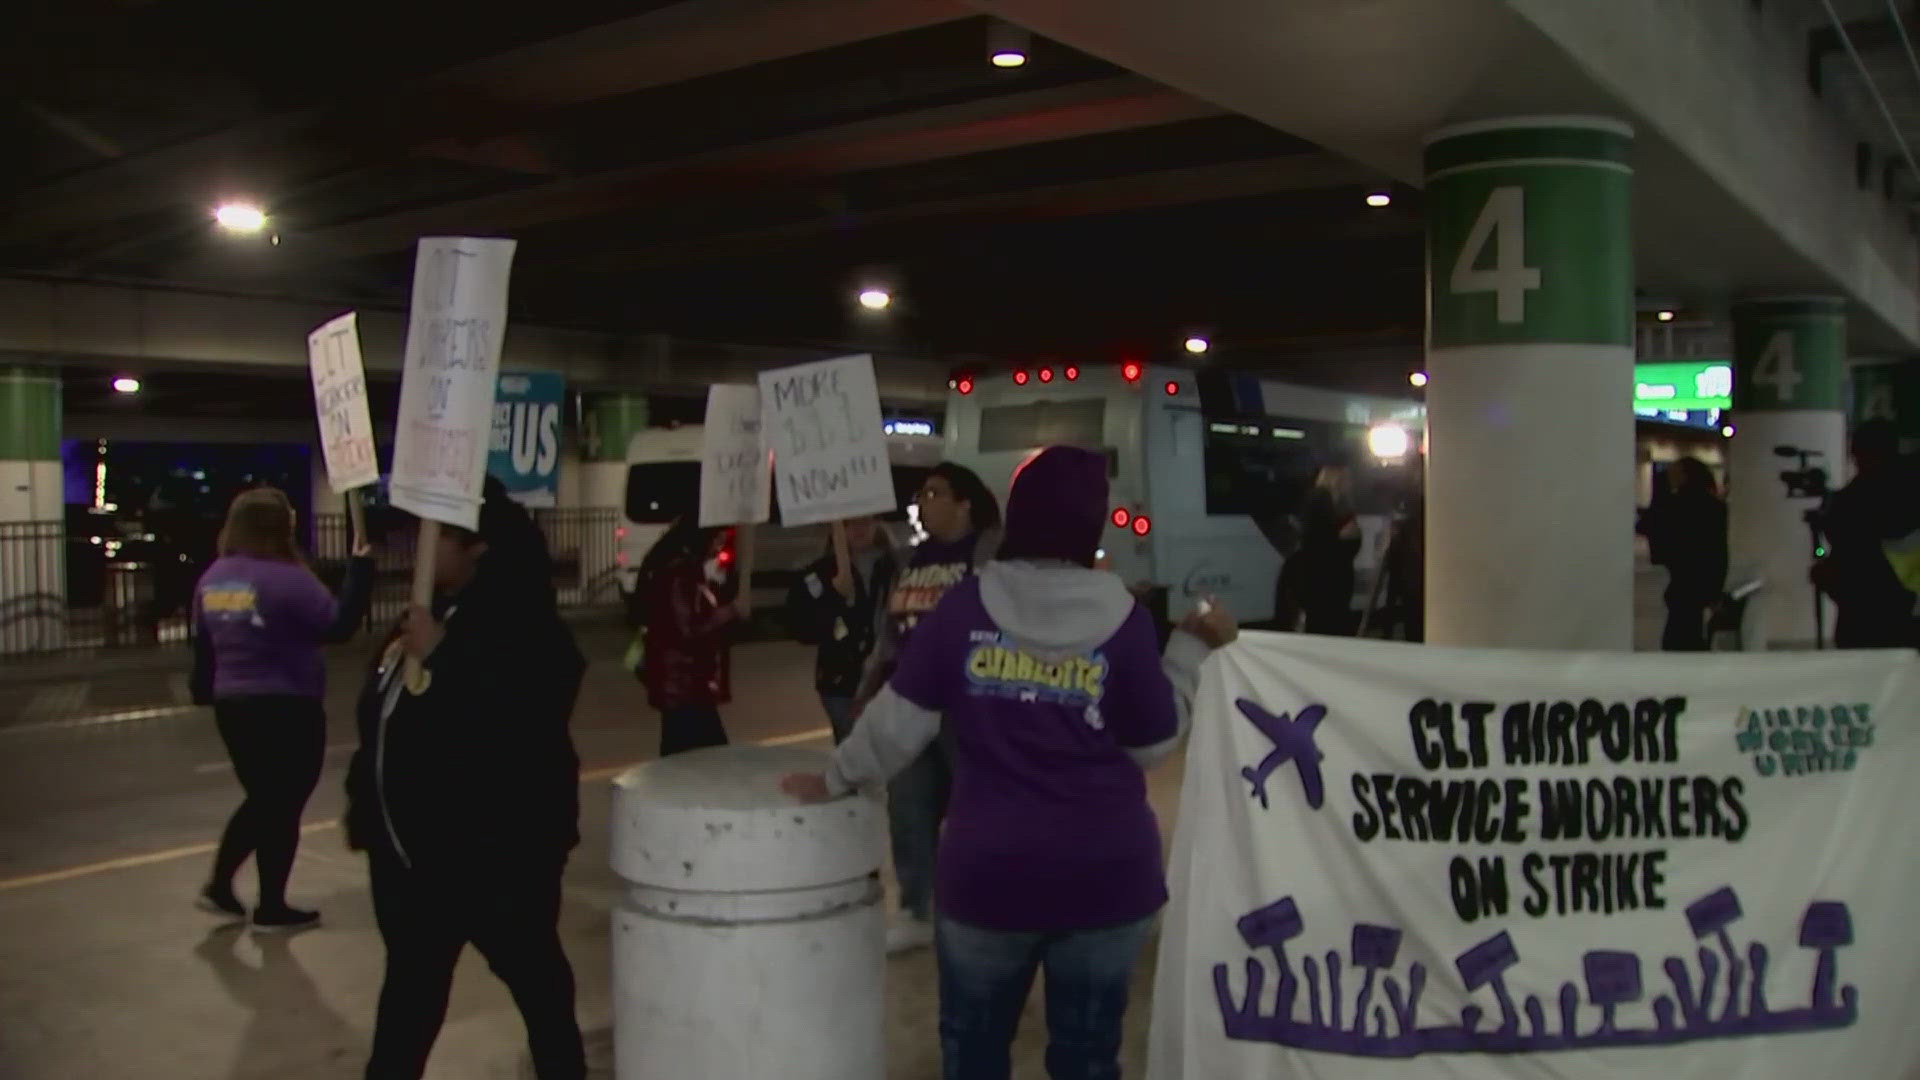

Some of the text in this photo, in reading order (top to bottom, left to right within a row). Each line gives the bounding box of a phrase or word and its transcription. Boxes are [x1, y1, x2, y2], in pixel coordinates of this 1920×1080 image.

[1449, 186, 1541, 324] 4
[773, 370, 845, 412] MORE
[1752, 330, 1802, 402] 4
[511, 401, 560, 476] US
[969, 647, 1103, 698] CHARLOTTE
[1409, 696, 1687, 771] CLT AIRPORT
[1748, 703, 1871, 733] AIRPORT
[1351, 773, 1749, 845] SERVICE WORKERS
[1448, 850, 1667, 923] ON STRIKE
